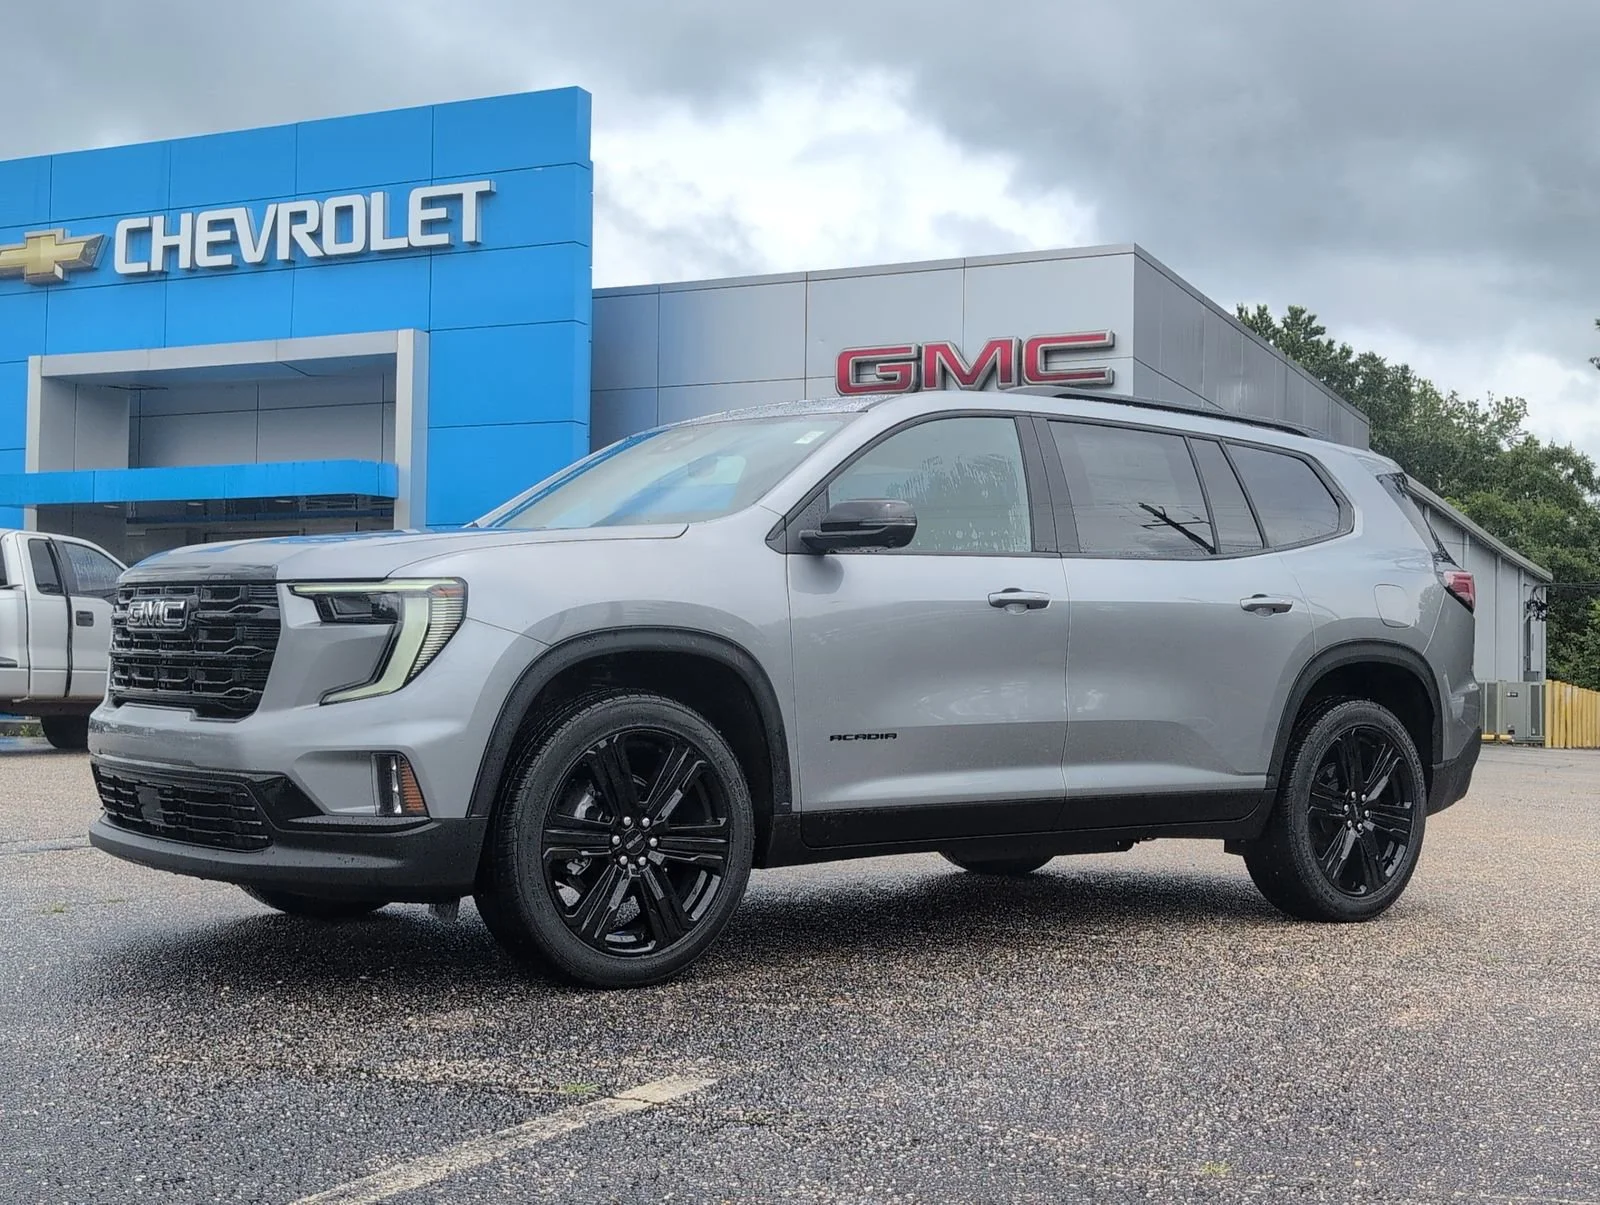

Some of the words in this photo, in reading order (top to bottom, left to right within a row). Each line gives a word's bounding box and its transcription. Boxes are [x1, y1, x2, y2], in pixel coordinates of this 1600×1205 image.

[114, 180, 495, 275] CHEVROLET
[835, 329, 1114, 396] GMC
[127, 600, 185, 627] GMC
[829, 733, 897, 741] ACADIA
